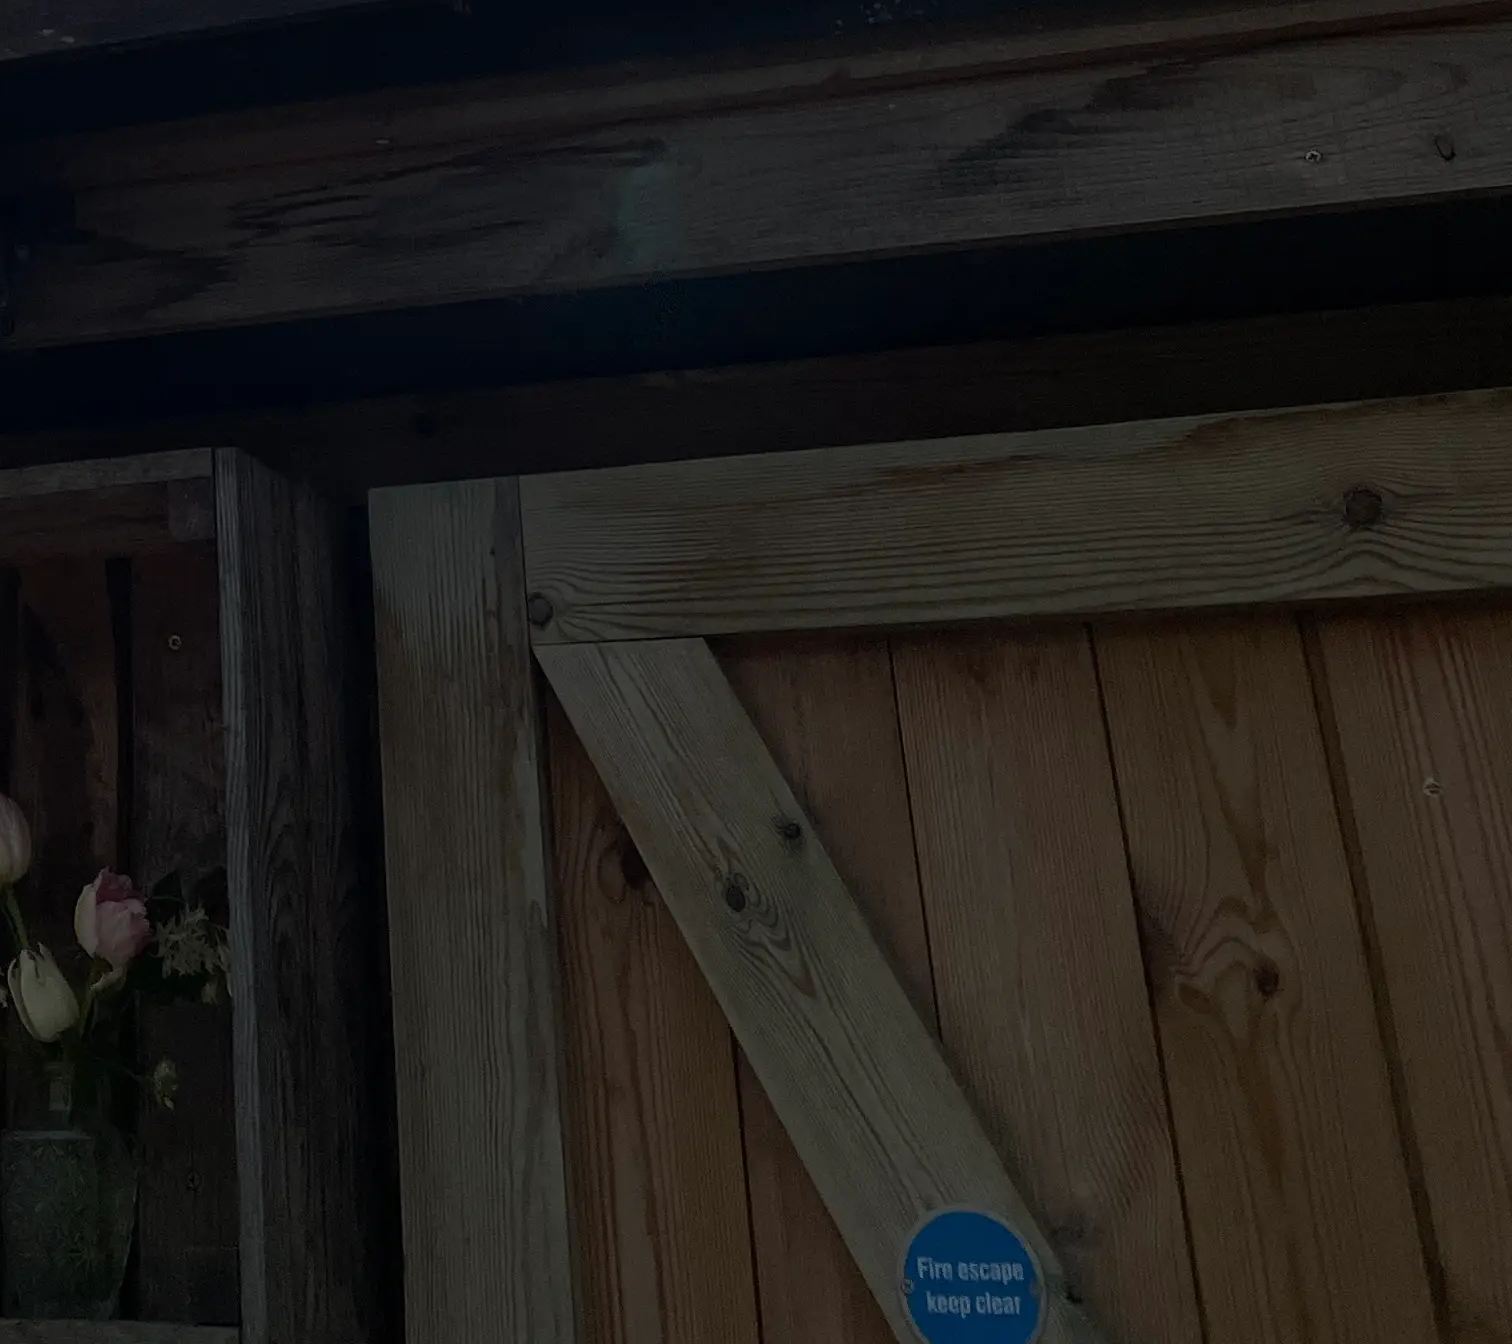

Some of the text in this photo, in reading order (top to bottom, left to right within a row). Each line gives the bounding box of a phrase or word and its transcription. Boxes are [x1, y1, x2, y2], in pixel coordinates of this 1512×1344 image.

[917, 1256, 1024, 1286] Fire escape
[925, 1290, 1021, 1319] keep clear
